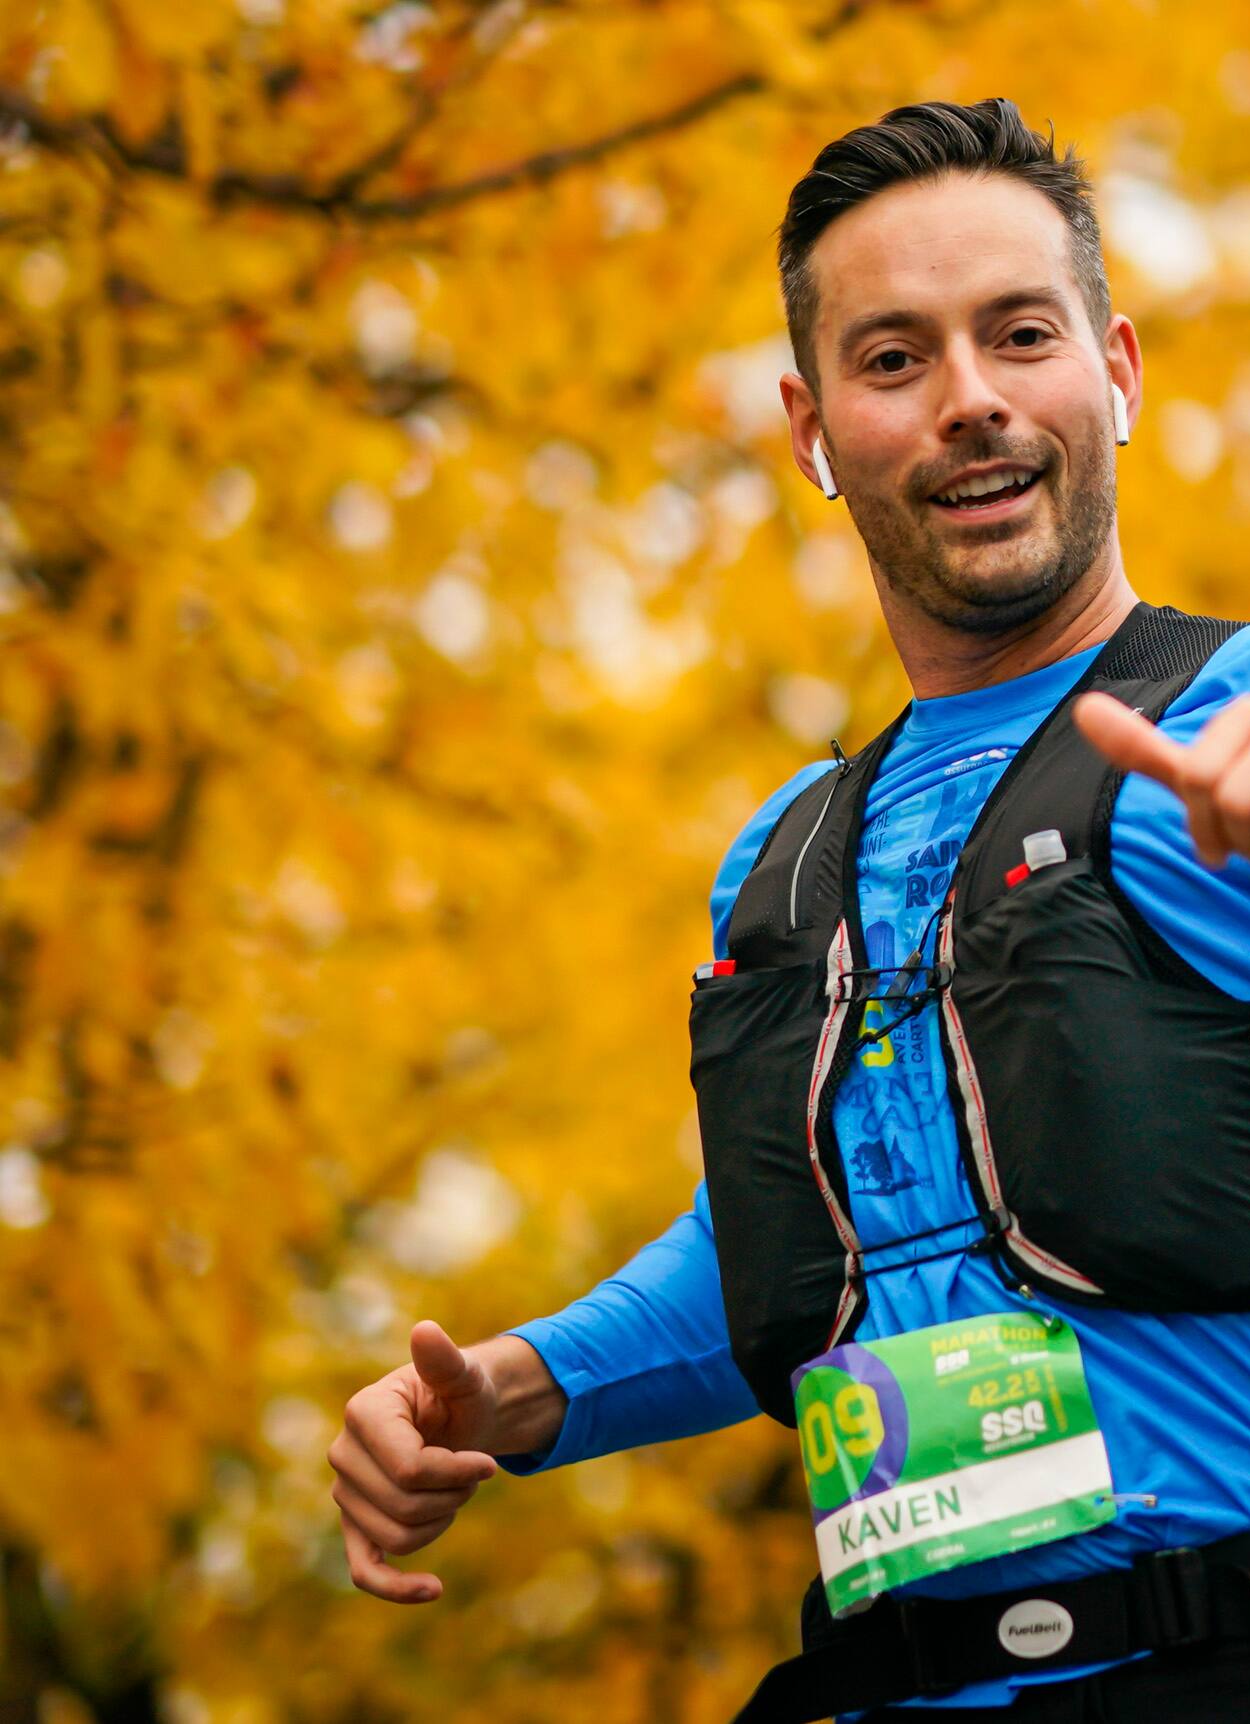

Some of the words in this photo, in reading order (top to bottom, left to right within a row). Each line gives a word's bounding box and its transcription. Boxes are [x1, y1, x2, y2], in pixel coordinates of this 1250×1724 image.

[930, 1325, 1048, 1355] MARATHON
[804, 1383, 885, 1476] 09
[981, 1399, 1047, 1442] SSQ
[837, 1486, 961, 1555] KAVEN
